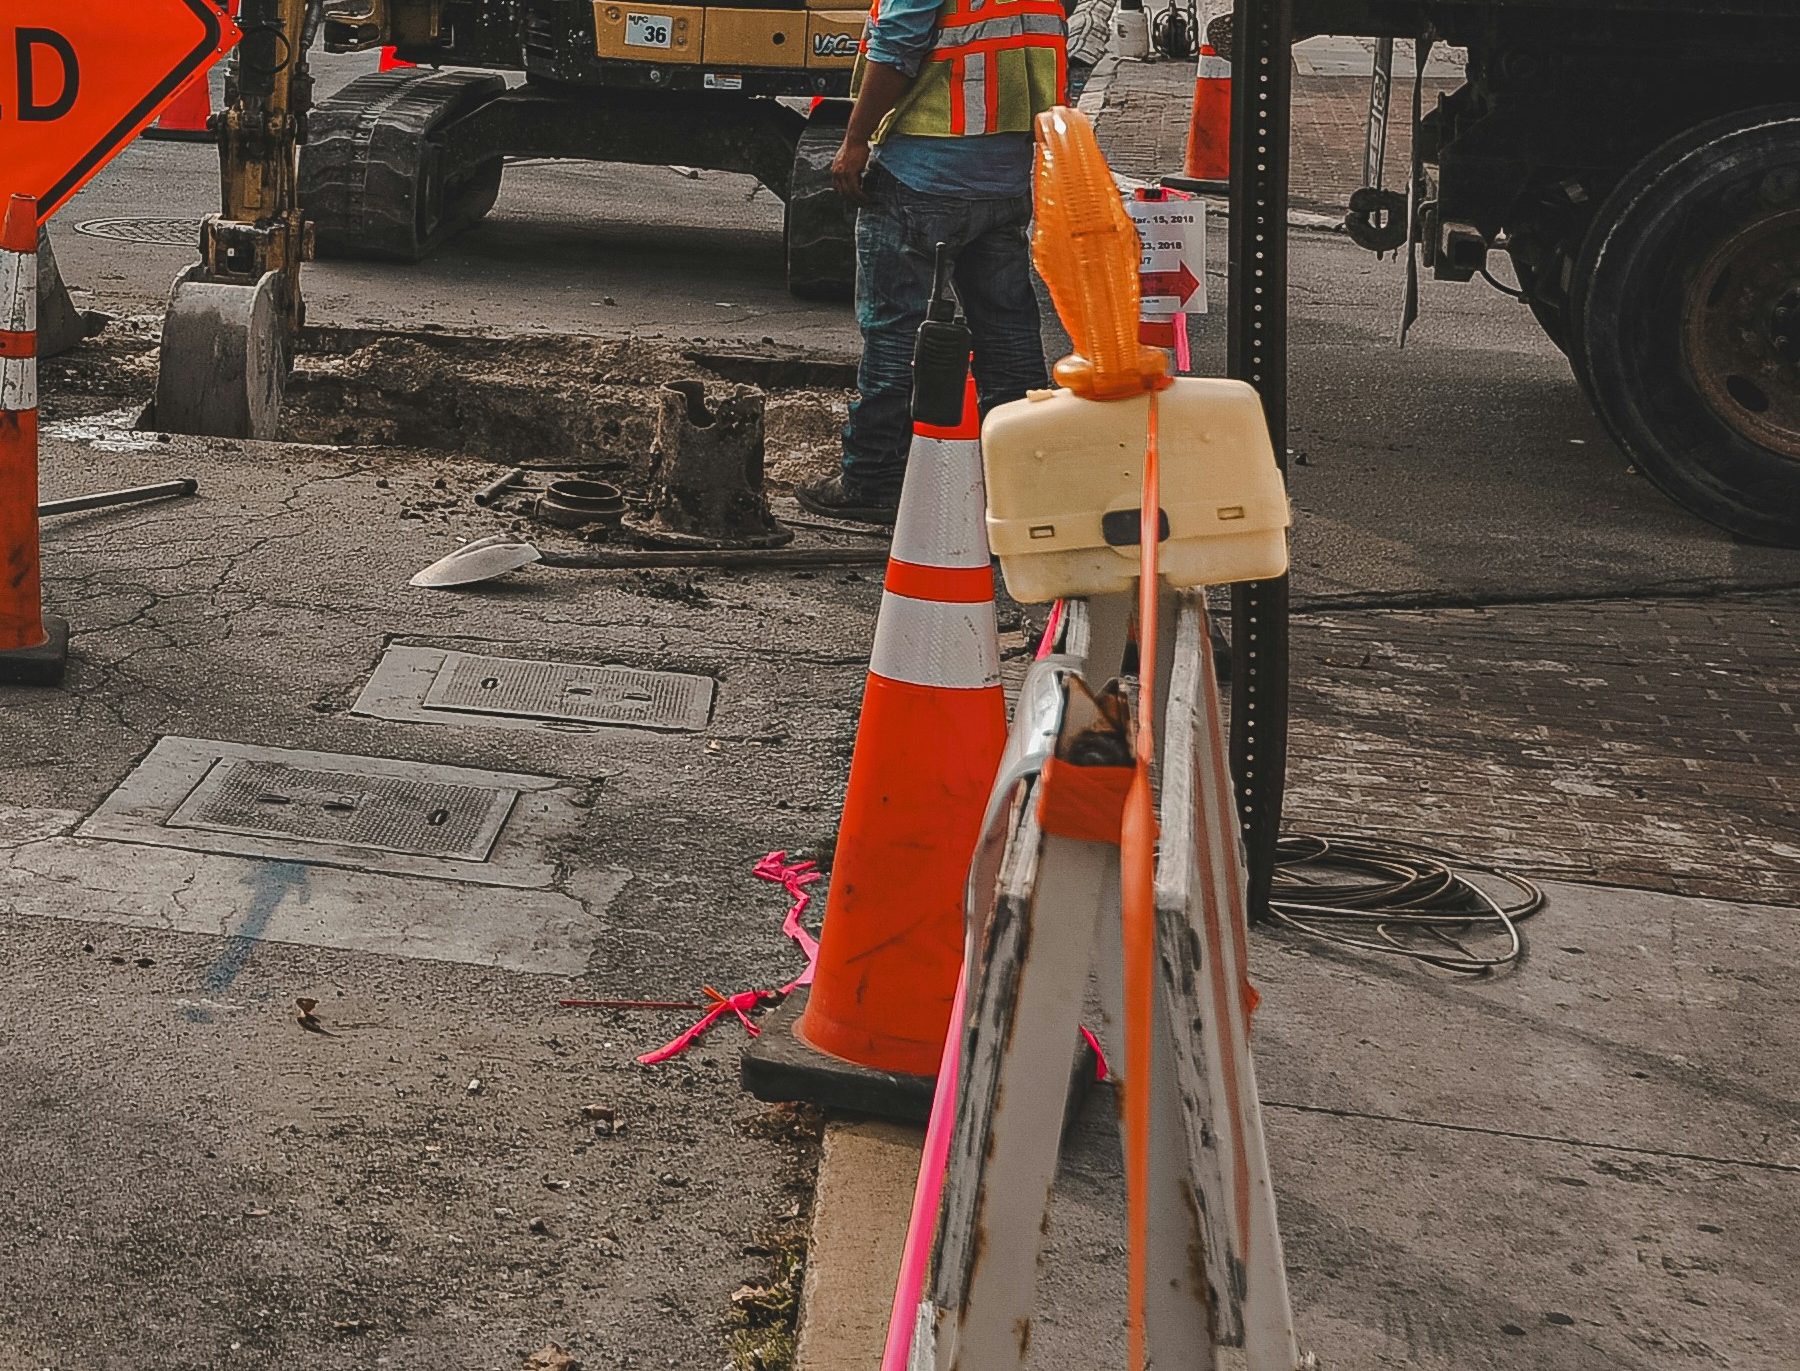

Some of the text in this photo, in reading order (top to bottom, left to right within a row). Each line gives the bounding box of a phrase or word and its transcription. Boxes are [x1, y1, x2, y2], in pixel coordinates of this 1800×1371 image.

[644, 25, 667, 44] 36
[1170, 215, 1194, 224] 2018
[1157, 241, 1182, 250] 2018
